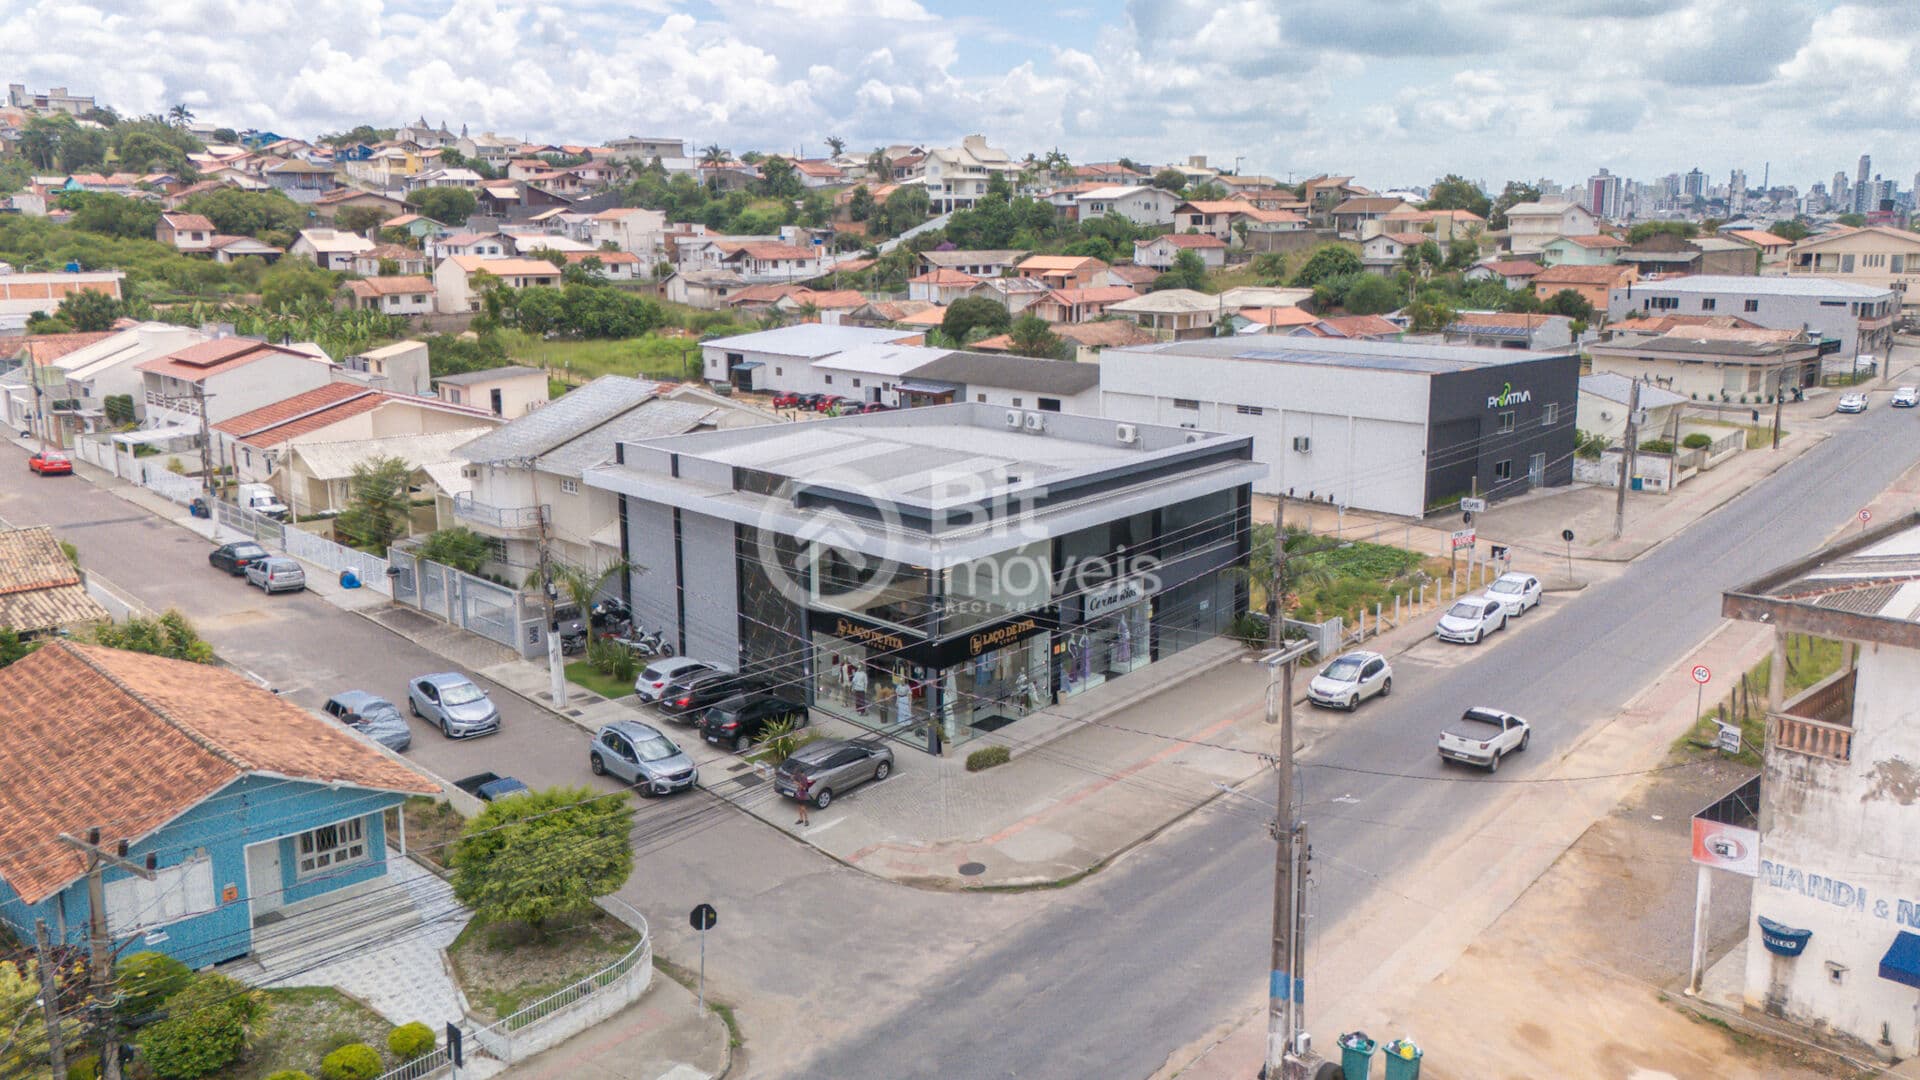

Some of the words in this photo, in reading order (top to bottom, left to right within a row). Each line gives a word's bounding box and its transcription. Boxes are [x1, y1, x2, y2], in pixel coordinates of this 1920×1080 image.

[983, 628, 1005, 645] LAÇO
[1006, 623, 1018, 637] DE
[1695, 668, 1708, 679] 40
[1872, 898, 1890, 920] &
